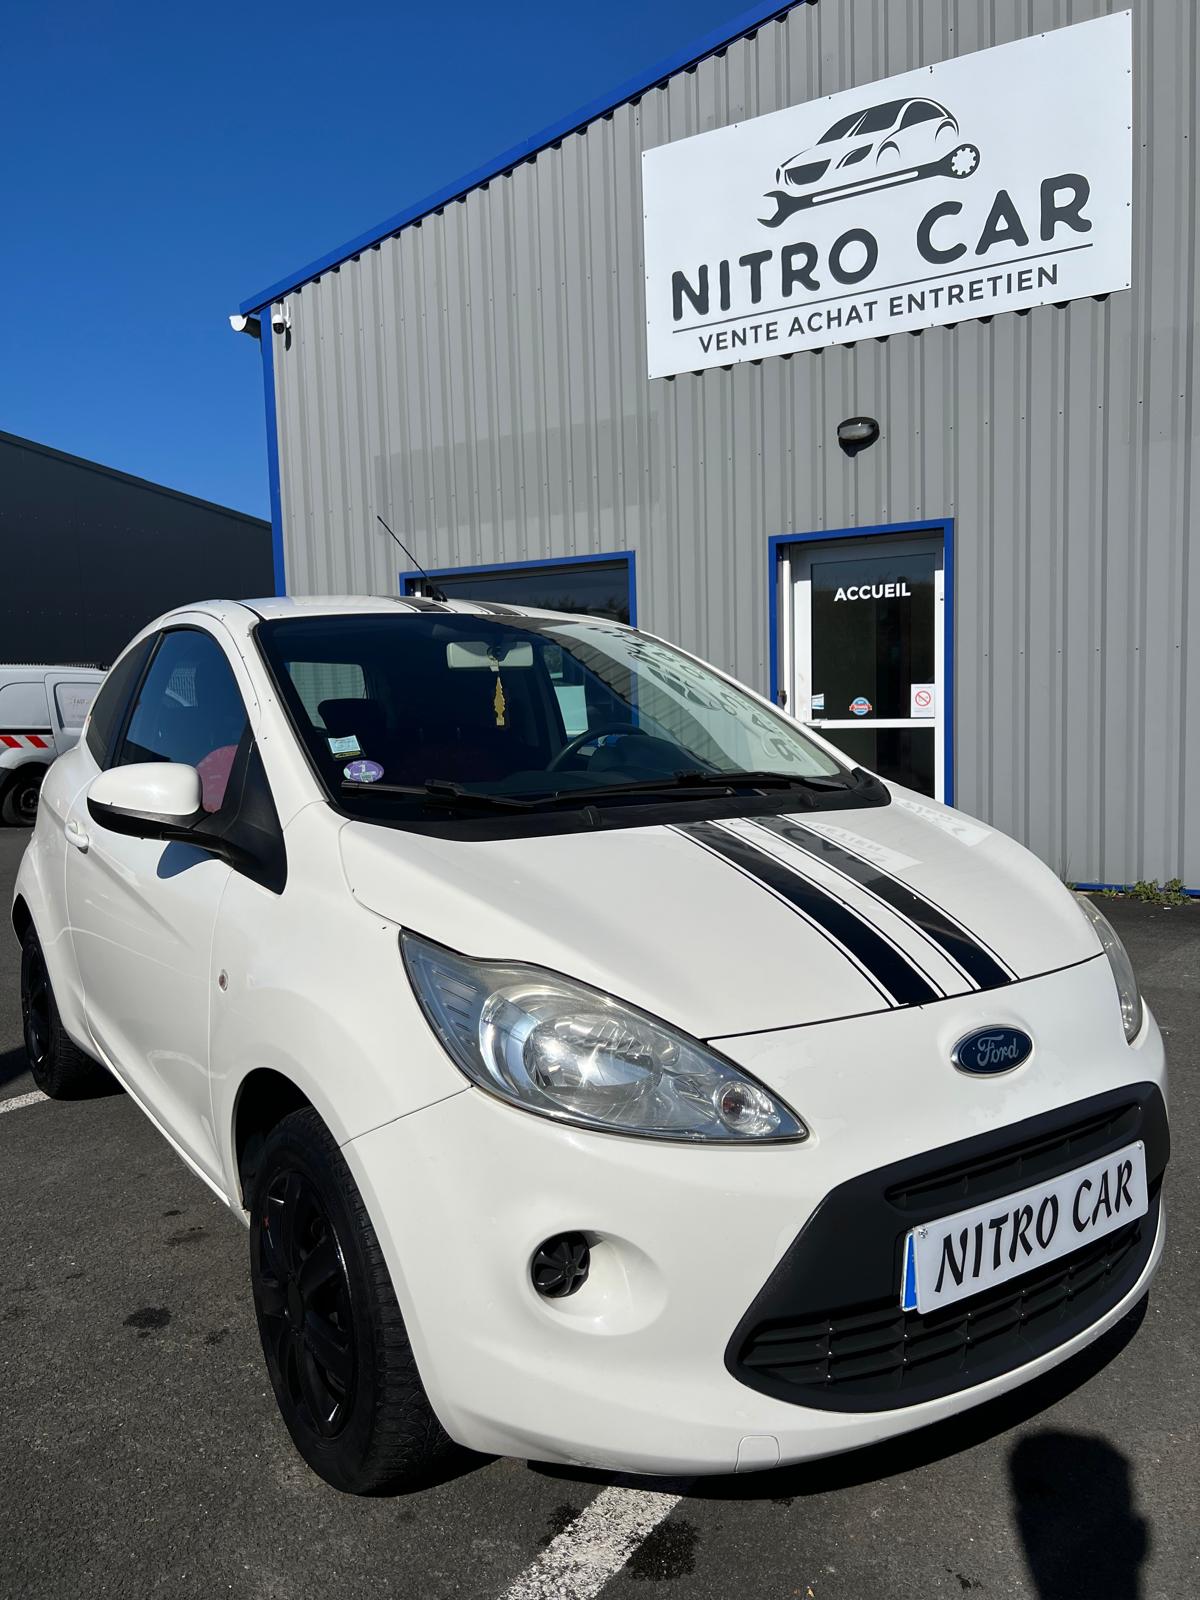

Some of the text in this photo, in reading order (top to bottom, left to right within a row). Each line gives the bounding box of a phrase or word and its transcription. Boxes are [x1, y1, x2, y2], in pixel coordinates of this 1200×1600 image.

[672, 174, 1093, 321] NITRO CAR
[699, 264, 1058, 353] VENTE ACHAT ENTRETIEN
[833, 582, 912, 602] ACCUEIL
[978, 1035, 1019, 1067] Ford
[935, 1160, 1133, 1293] NITRO CAR
